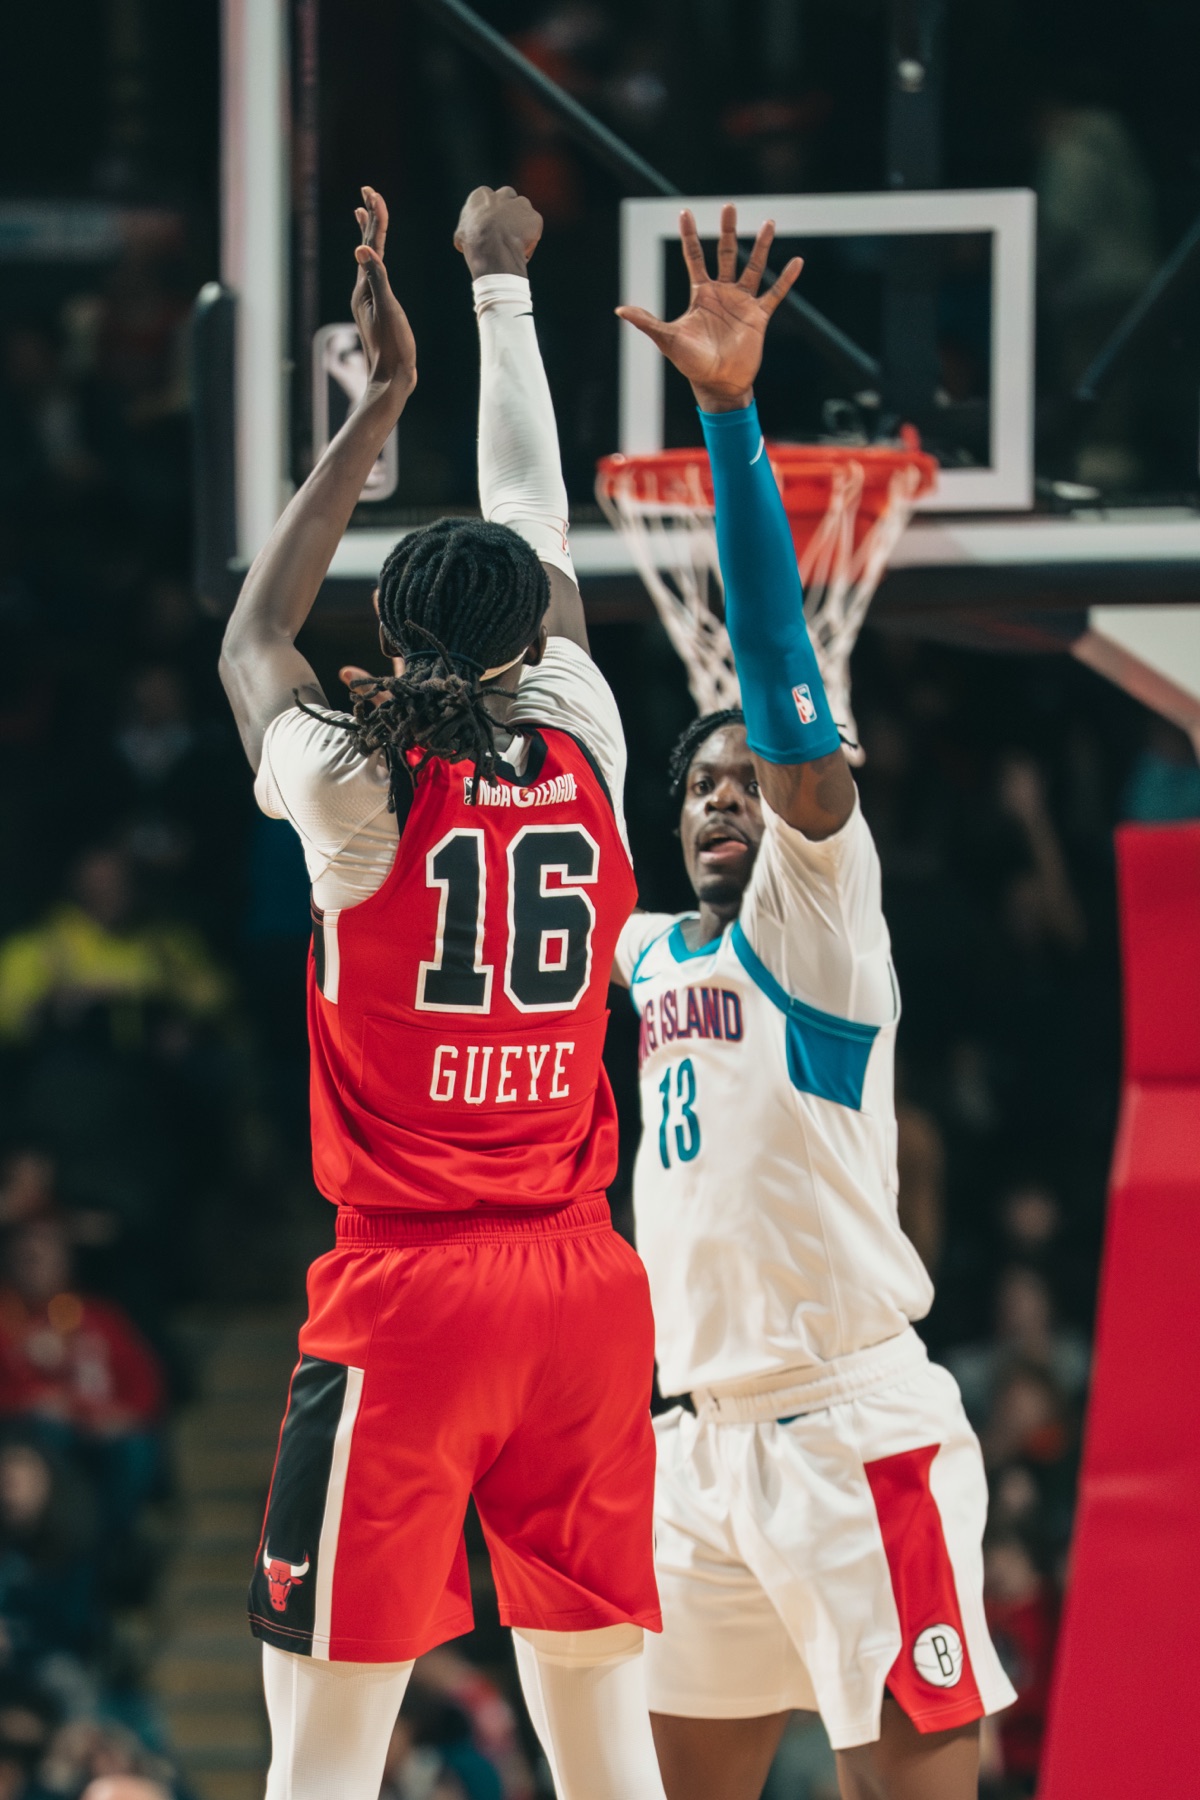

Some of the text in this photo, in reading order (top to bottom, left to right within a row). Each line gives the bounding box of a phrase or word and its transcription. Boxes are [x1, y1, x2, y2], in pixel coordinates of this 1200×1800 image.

[478, 779, 511, 807] NBA
[534, 773, 578, 807] LEAGUE
[415, 823, 600, 1014] 16
[637, 986, 744, 1069] NG ISLAND
[429, 1041, 575, 1104] GUEYE
[659, 1057, 701, 1169] 13
[931, 1635, 954, 1677] B
